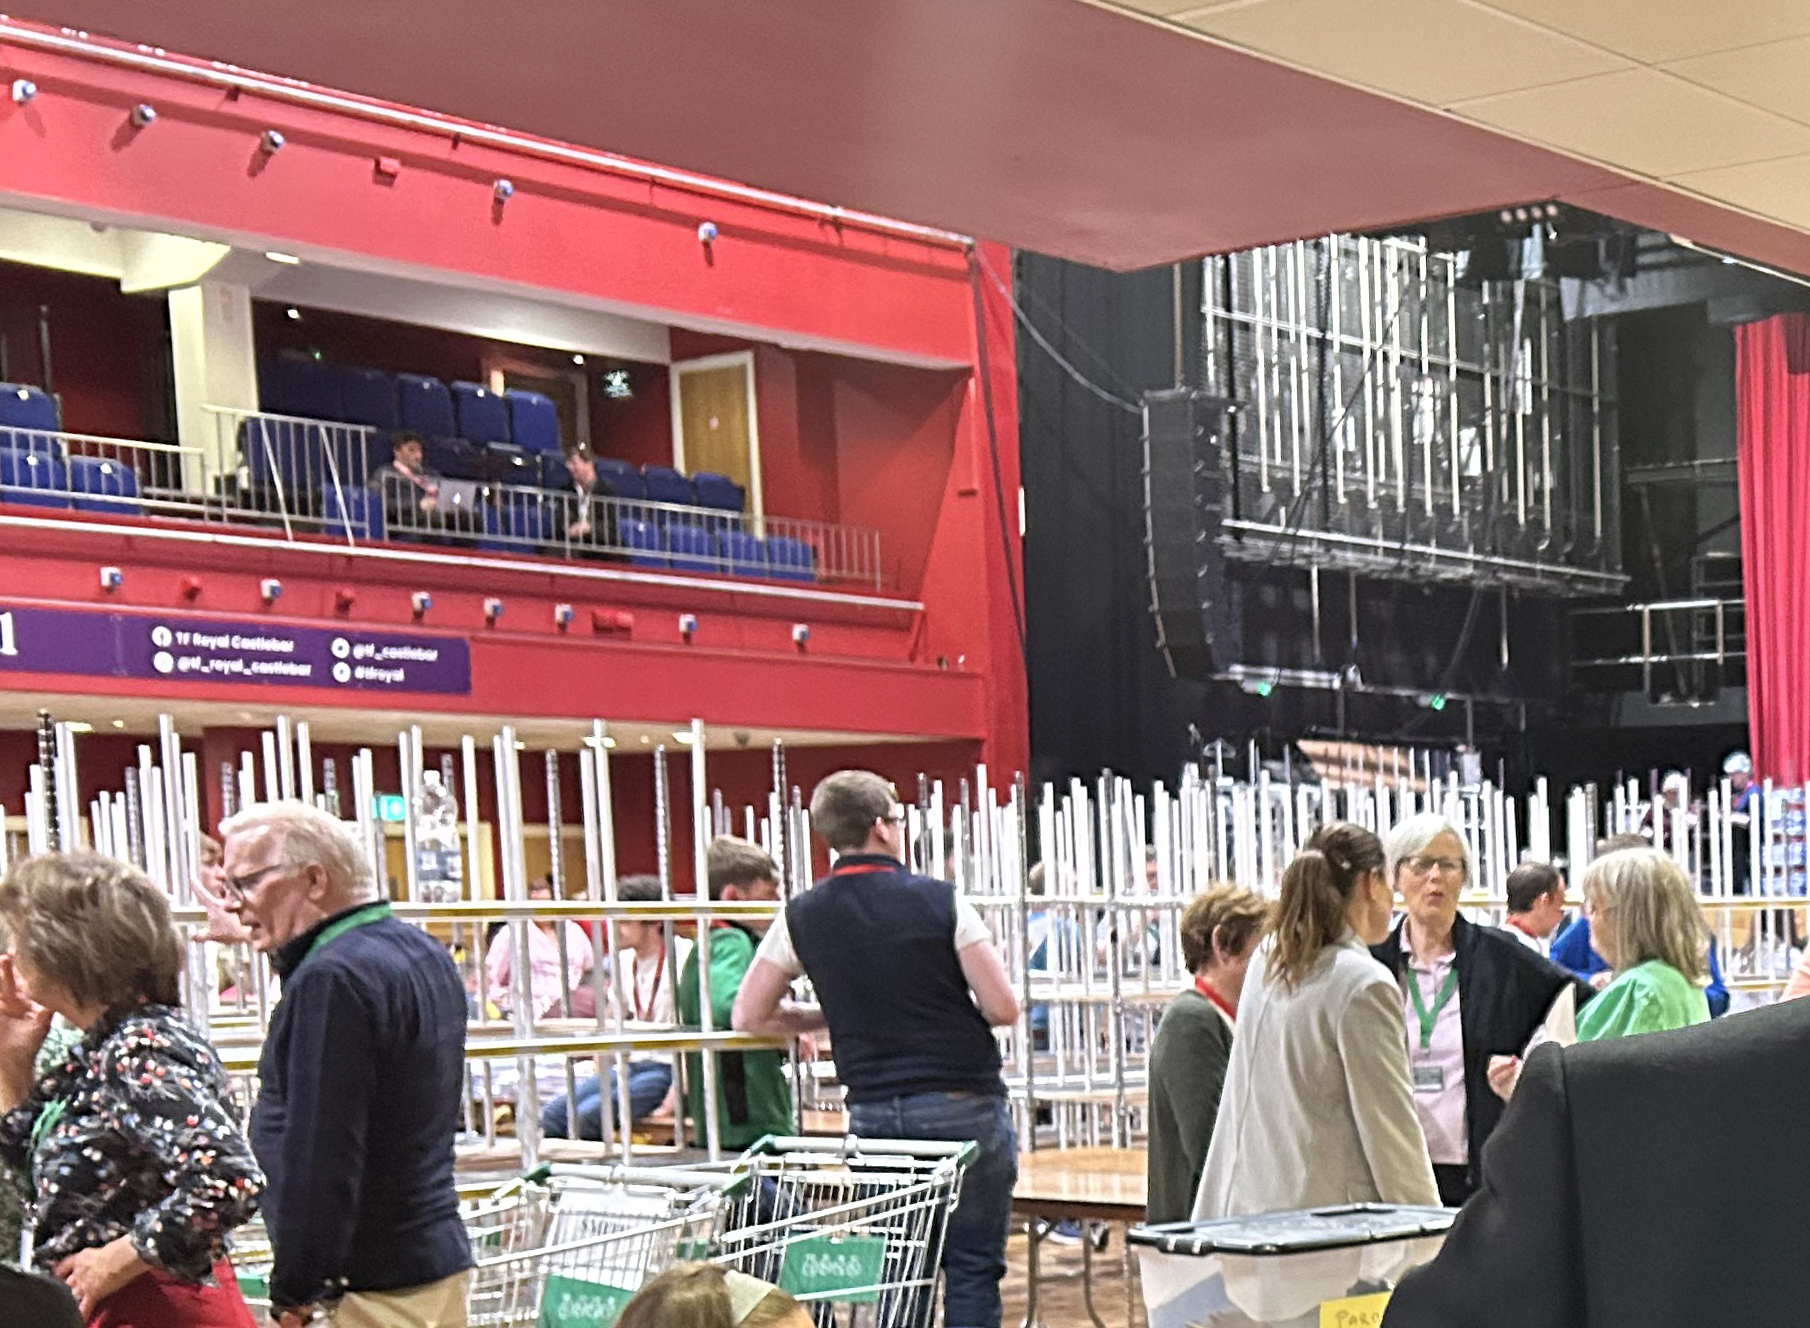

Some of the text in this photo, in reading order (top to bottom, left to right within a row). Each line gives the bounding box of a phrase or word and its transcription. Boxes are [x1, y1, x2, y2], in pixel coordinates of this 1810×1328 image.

[175, 631, 294, 652] TF Royal Castlebar
